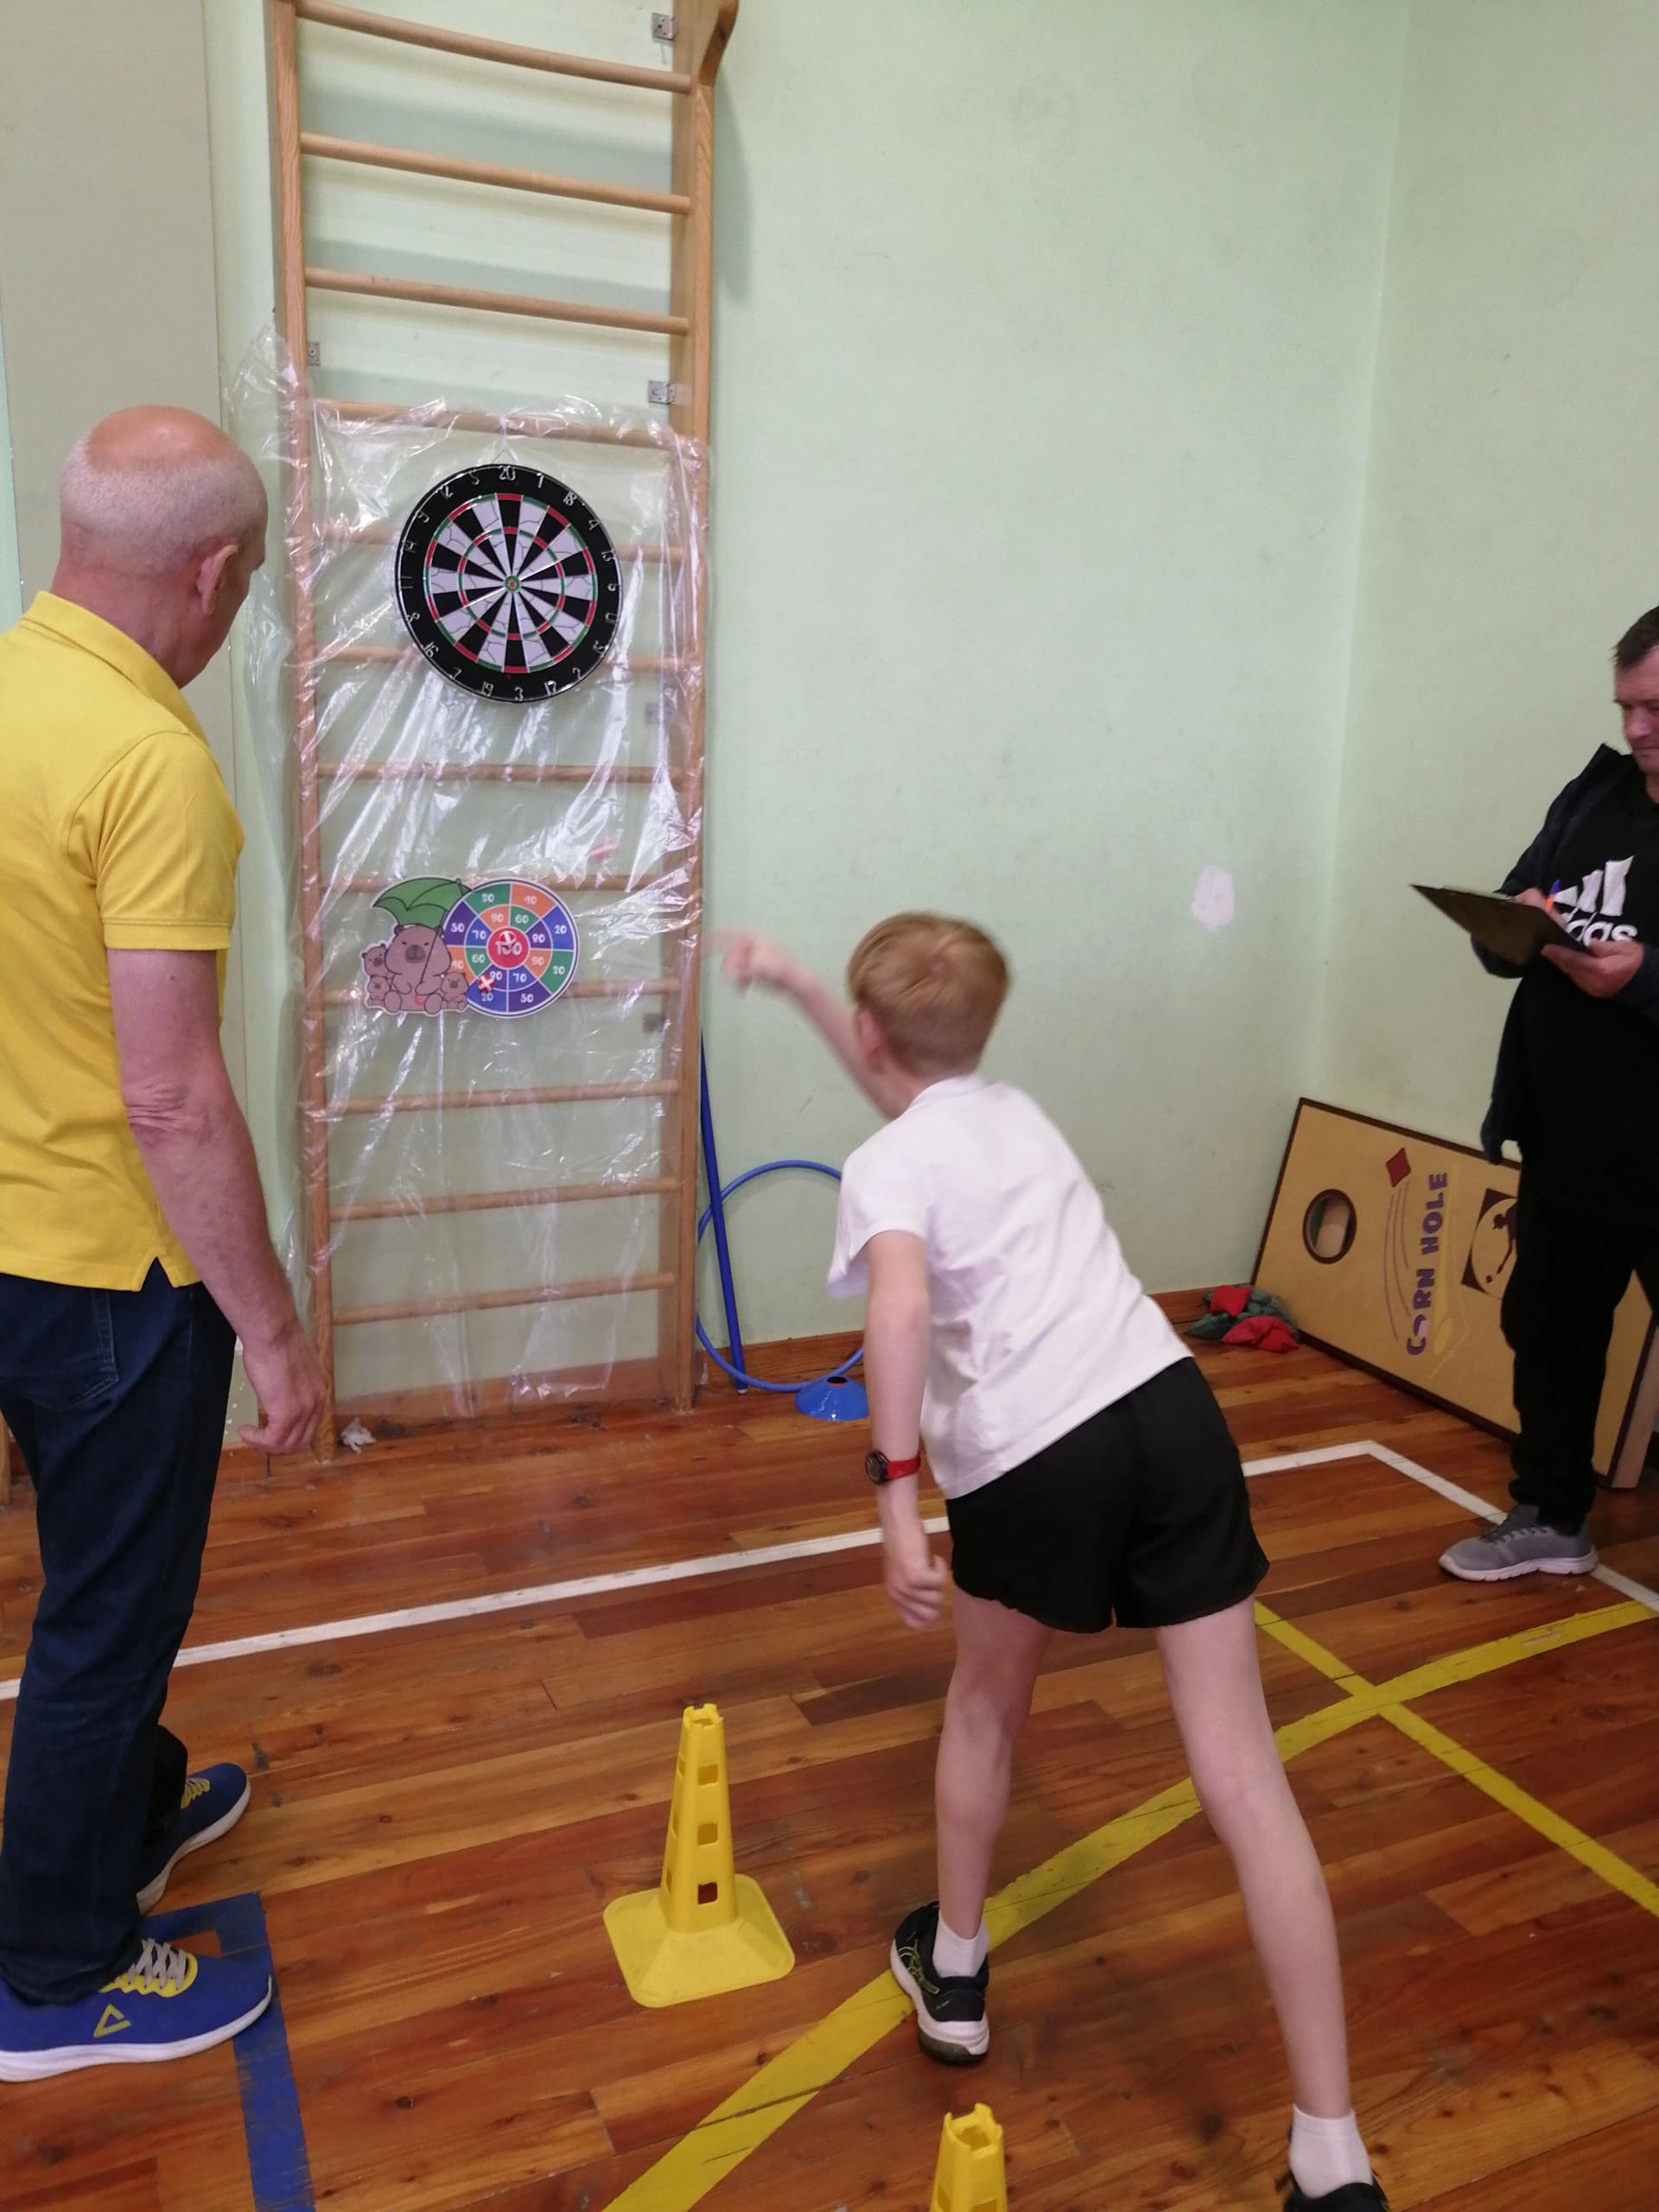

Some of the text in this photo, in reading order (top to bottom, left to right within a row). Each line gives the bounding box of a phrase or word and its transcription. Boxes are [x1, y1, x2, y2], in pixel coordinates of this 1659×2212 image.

[499, 465, 517, 480] 20
[563, 490, 579, 506] 18
[423, 641, 440, 658] 16
[480, 680, 494, 698] 19
[513, 685, 524, 702] 3
[514, 913, 530, 924] 60
[450, 922, 465, 933] 50
[554, 924, 568, 935] 20
[471, 930, 486, 940] 70
[471, 953, 486, 964] 60
[512, 972, 527, 983] 70
[520, 993, 535, 1003] 50
[1420, 1172, 1449, 1255] HOLE
